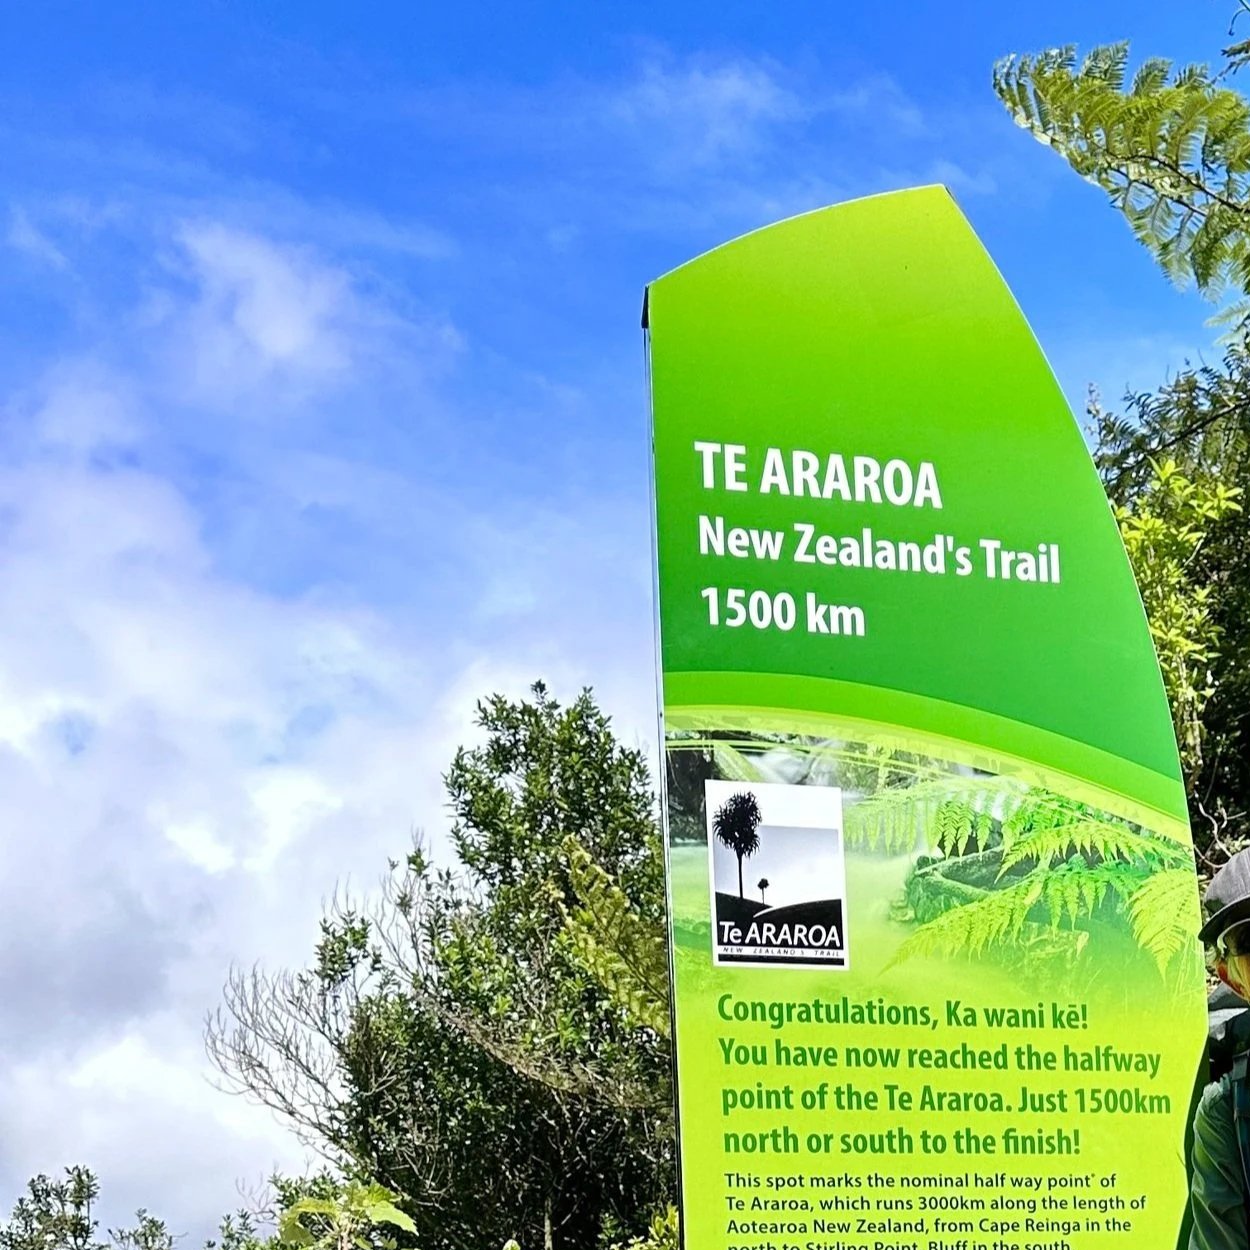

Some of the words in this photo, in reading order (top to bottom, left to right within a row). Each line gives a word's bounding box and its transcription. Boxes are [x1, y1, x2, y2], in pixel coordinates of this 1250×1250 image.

[694, 441, 748, 492] TE
[760, 447, 943, 509] ARAROA
[698, 515, 784, 560] New
[793, 523, 973, 576] Zealand's
[979, 539, 1061, 583] Trail
[701, 586, 796, 631] 1500
[806, 592, 866, 636] km
[719, 921, 743, 944] Te
[744, 922, 841, 947] ARAROA
[717, 994, 938, 1030] Congratulations,
[946, 1000, 977, 1028] Ka
[984, 1003, 1045, 1029] wani
[1052, 1002, 1089, 1029] kē!
[719, 1038, 768, 1066] You
[775, 1039, 838, 1067] have
[845, 1046, 900, 1068] now
[908, 1043, 1008, 1070] reached
[1014, 1045, 1057, 1071] the
[1063, 1045, 1161, 1079] halfway
[722, 1082, 794, 1116] point
[800, 1083, 828, 1110] of
[834, 1084, 879, 1111] the
[884, 1085, 913, 1111] Te
[919, 1085, 1012, 1112] Araroa.
[1018, 1087, 1068, 1113] Just
[1074, 1088, 1171, 1114] 1500km
[724, 1126, 799, 1154] north
[807, 1133, 834, 1154] or
[840, 1127, 913, 1154] south
[920, 1130, 947, 1154] to
[953, 1128, 996, 1155] the
[1002, 1128, 1081, 1155] finish!
[725, 1173, 761, 1188] This
[766, 1174, 805, 1191] spot
[810, 1173, 862, 1188] marks
[867, 1173, 895, 1188] the
[900, 1173, 969, 1188] nominal
[974, 1173, 1006, 1188] half
[1010, 1177, 1042, 1191] way
[1100, 1173, 1117, 1188] of
[726, 1196, 745, 1211] Te
[751, 1196, 814, 1213] Araroa,
[819, 1196, 871, 1211] which
[876, 1198, 914, 1211] runs
[918, 1196, 985, 1211] 3000km
[990, 1196, 1037, 1214] along
[1042, 1196, 1069, 1210] the
[1073, 1196, 1125, 1213] length
[1130, 1195, 1146, 1210] of
[727, 1219, 808, 1234] Aotearoa
[813, 1219, 851, 1234] New
[856, 1219, 930, 1235] Zealand,
[934, 1218, 974, 1233] from
[978, 1219, 1021, 1236] Cape
[1025, 1218, 1081, 1236] Reinga
[1085, 1217, 1101, 1232] in
[1105, 1217, 1132, 1232] the
